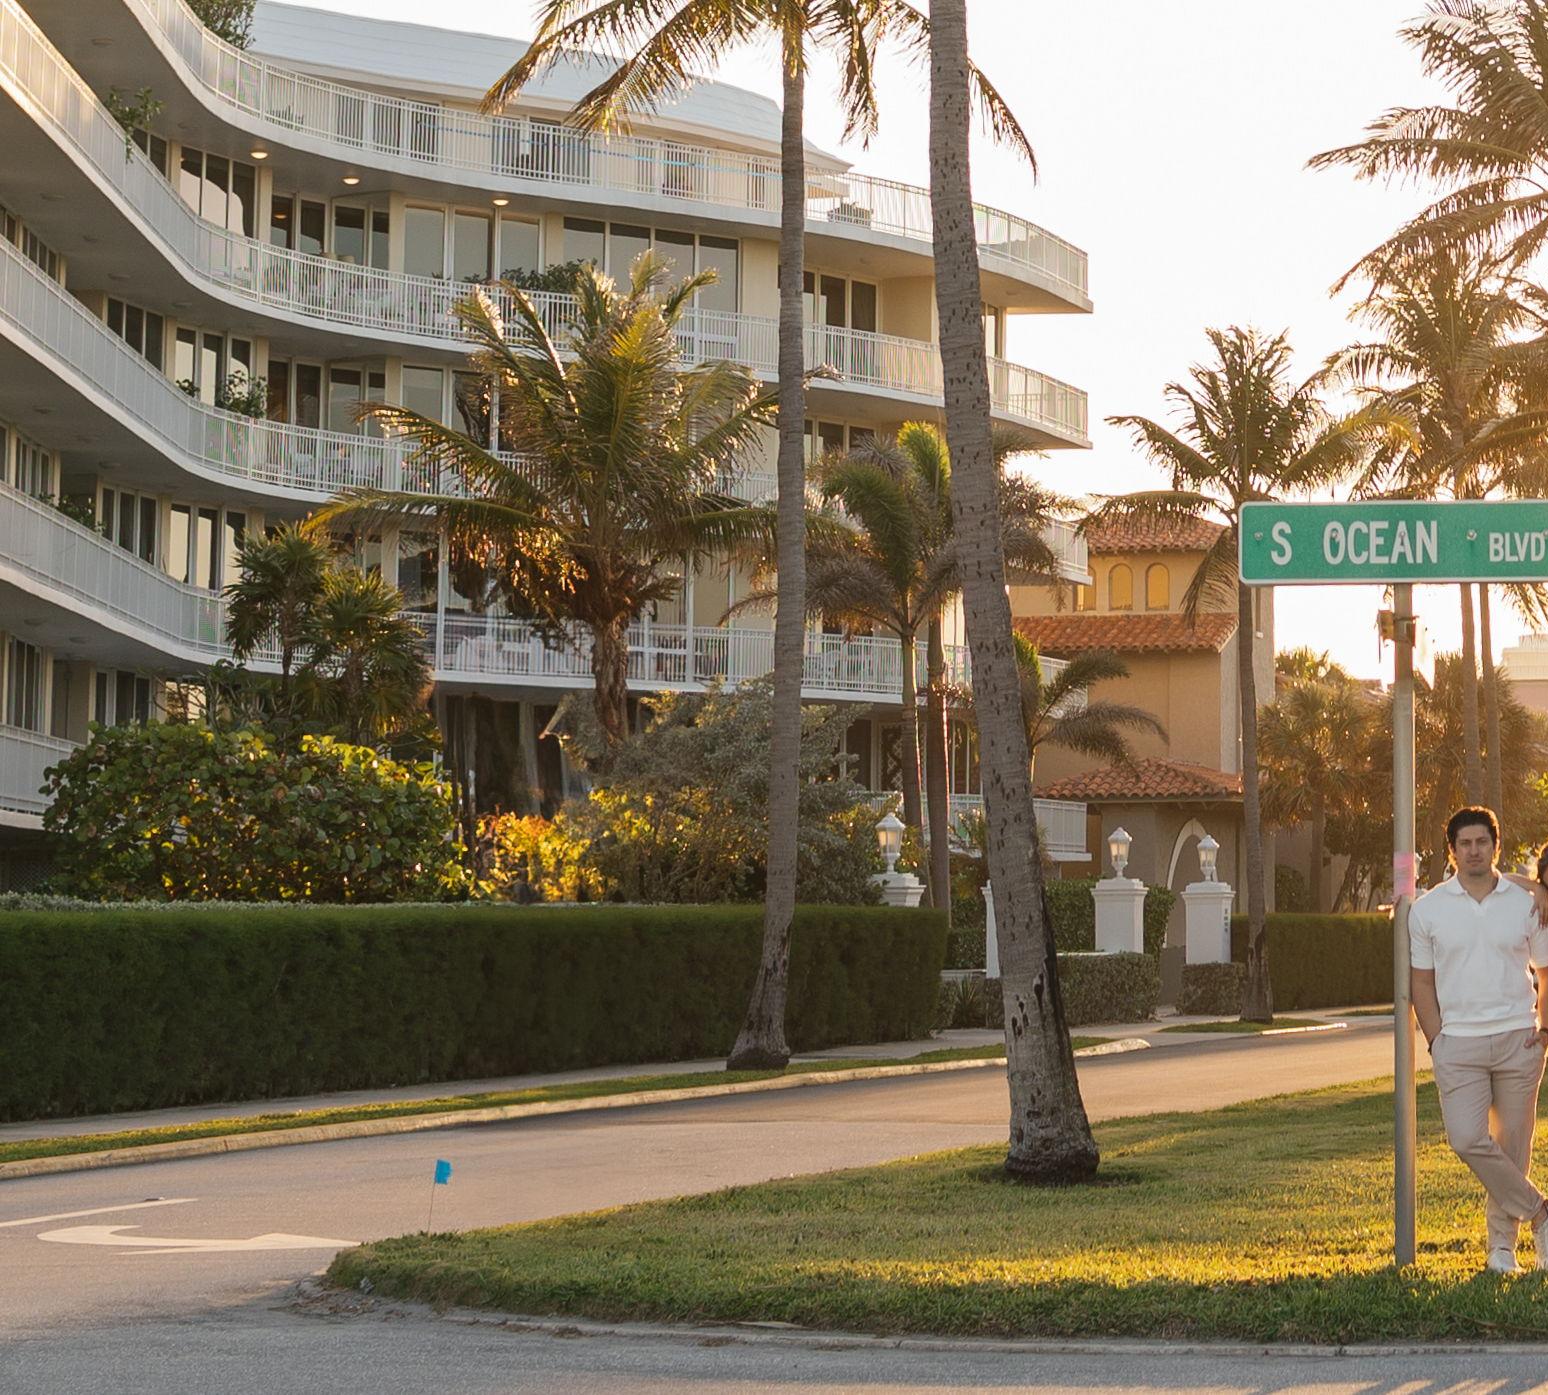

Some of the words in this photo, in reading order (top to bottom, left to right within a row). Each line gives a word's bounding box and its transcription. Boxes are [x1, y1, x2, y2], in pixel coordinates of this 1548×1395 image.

[1270, 521, 1292, 565] S
[1323, 520, 1438, 565] OCEAN
[1489, 532, 1546, 562] BLVD
